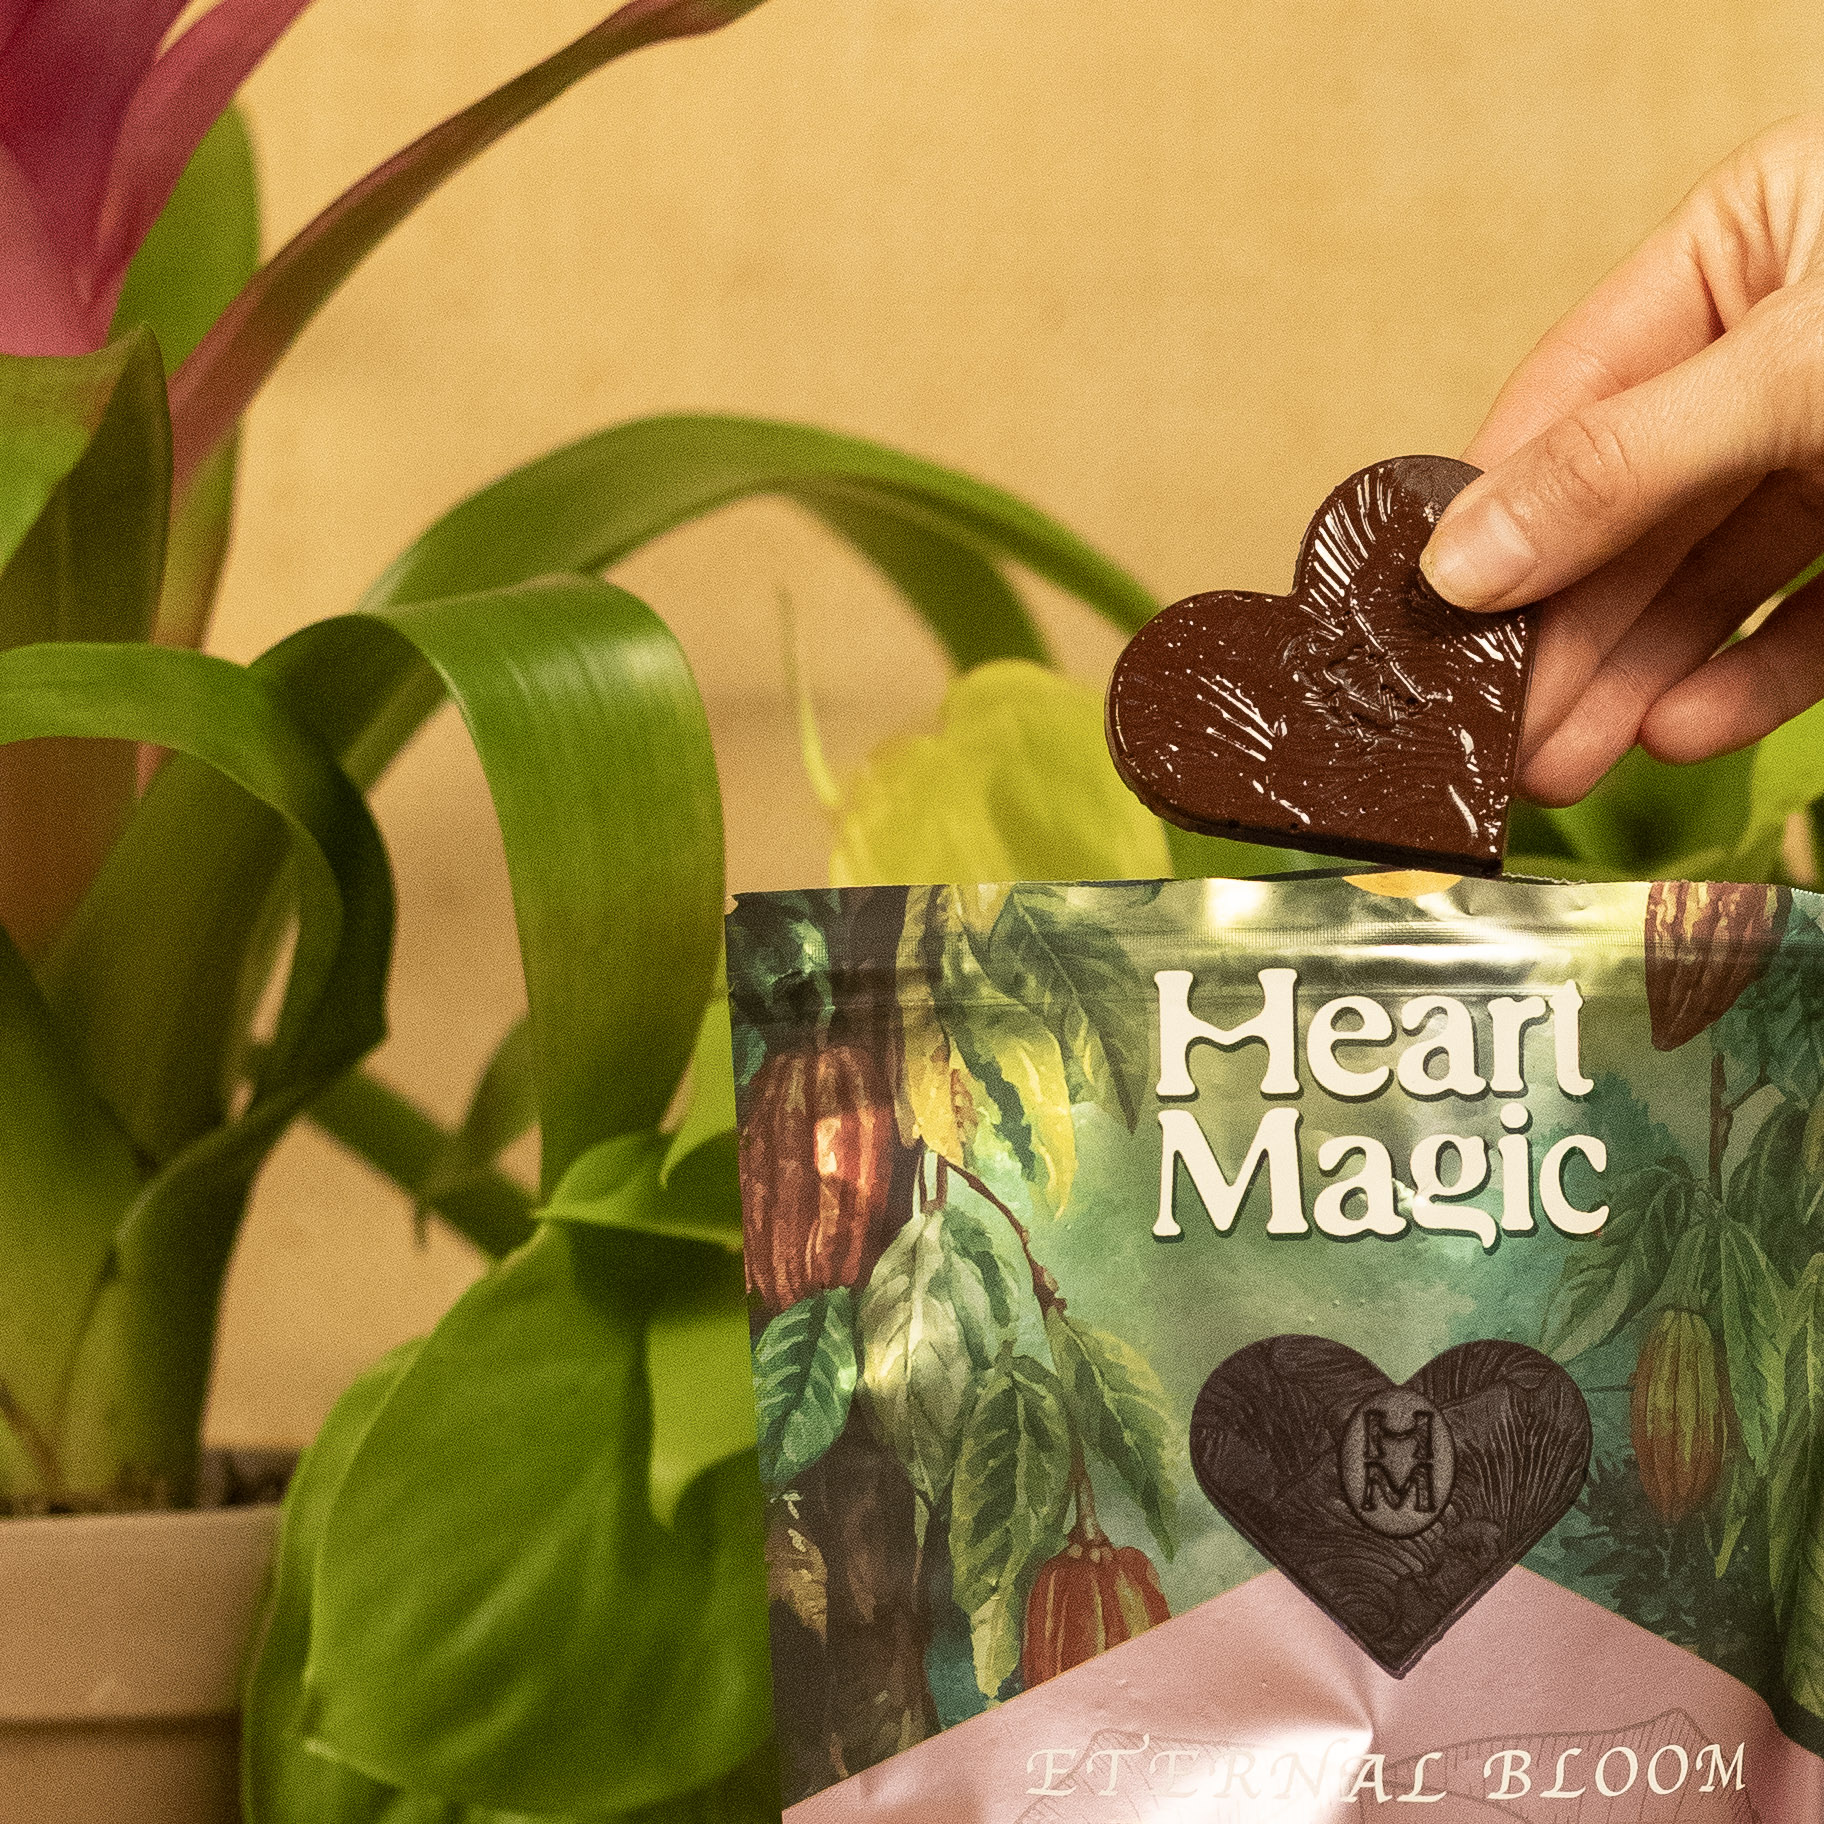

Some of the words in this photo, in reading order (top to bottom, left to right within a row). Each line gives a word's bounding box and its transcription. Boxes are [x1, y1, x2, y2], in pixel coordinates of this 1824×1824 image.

[1153, 967, 1595, 1099] Heart
[1152, 1102, 1610, 1250] Magic
[1025, 1732, 1448, 1804] ETERNAL
[1484, 1741, 1746, 1800] BLOOM
